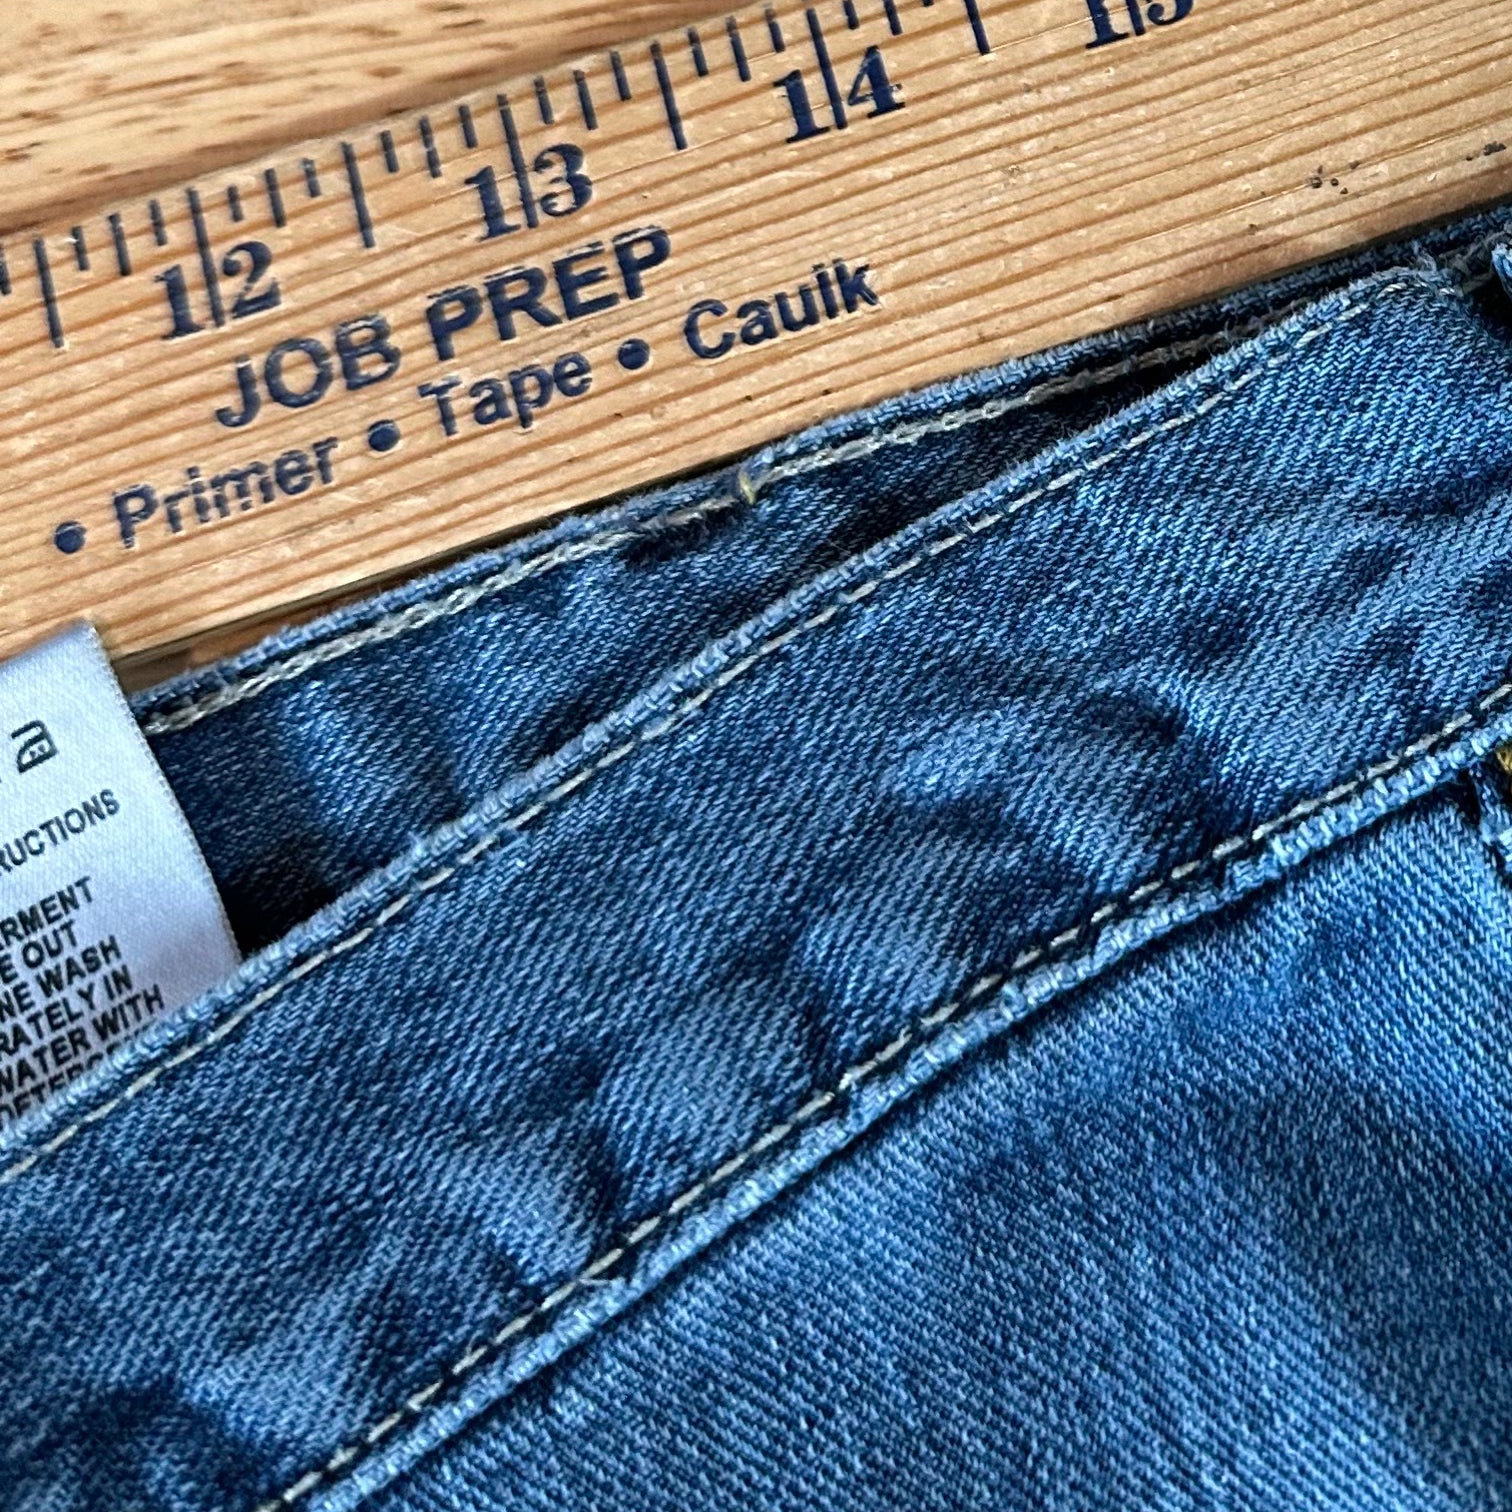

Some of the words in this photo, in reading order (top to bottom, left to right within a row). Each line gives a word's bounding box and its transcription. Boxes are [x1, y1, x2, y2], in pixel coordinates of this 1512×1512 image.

[155, 240, 281, 341] 12
[464, 143, 592, 240] 13
[773, 45, 906, 143] 14
[215, 313, 402, 428] JOB
[426, 225, 671, 361] PREP
[112, 436, 339, 550] Primer
[418, 351, 593, 437] Tape
[683, 258, 879, 360] Caulk
[0, 875, 93, 949] RMENT
[22, 919, 77, 969] OUT
[36, 935, 121, 998] WASH
[103, 964, 133, 1001] IN
[92, 984, 165, 1041] WITH
